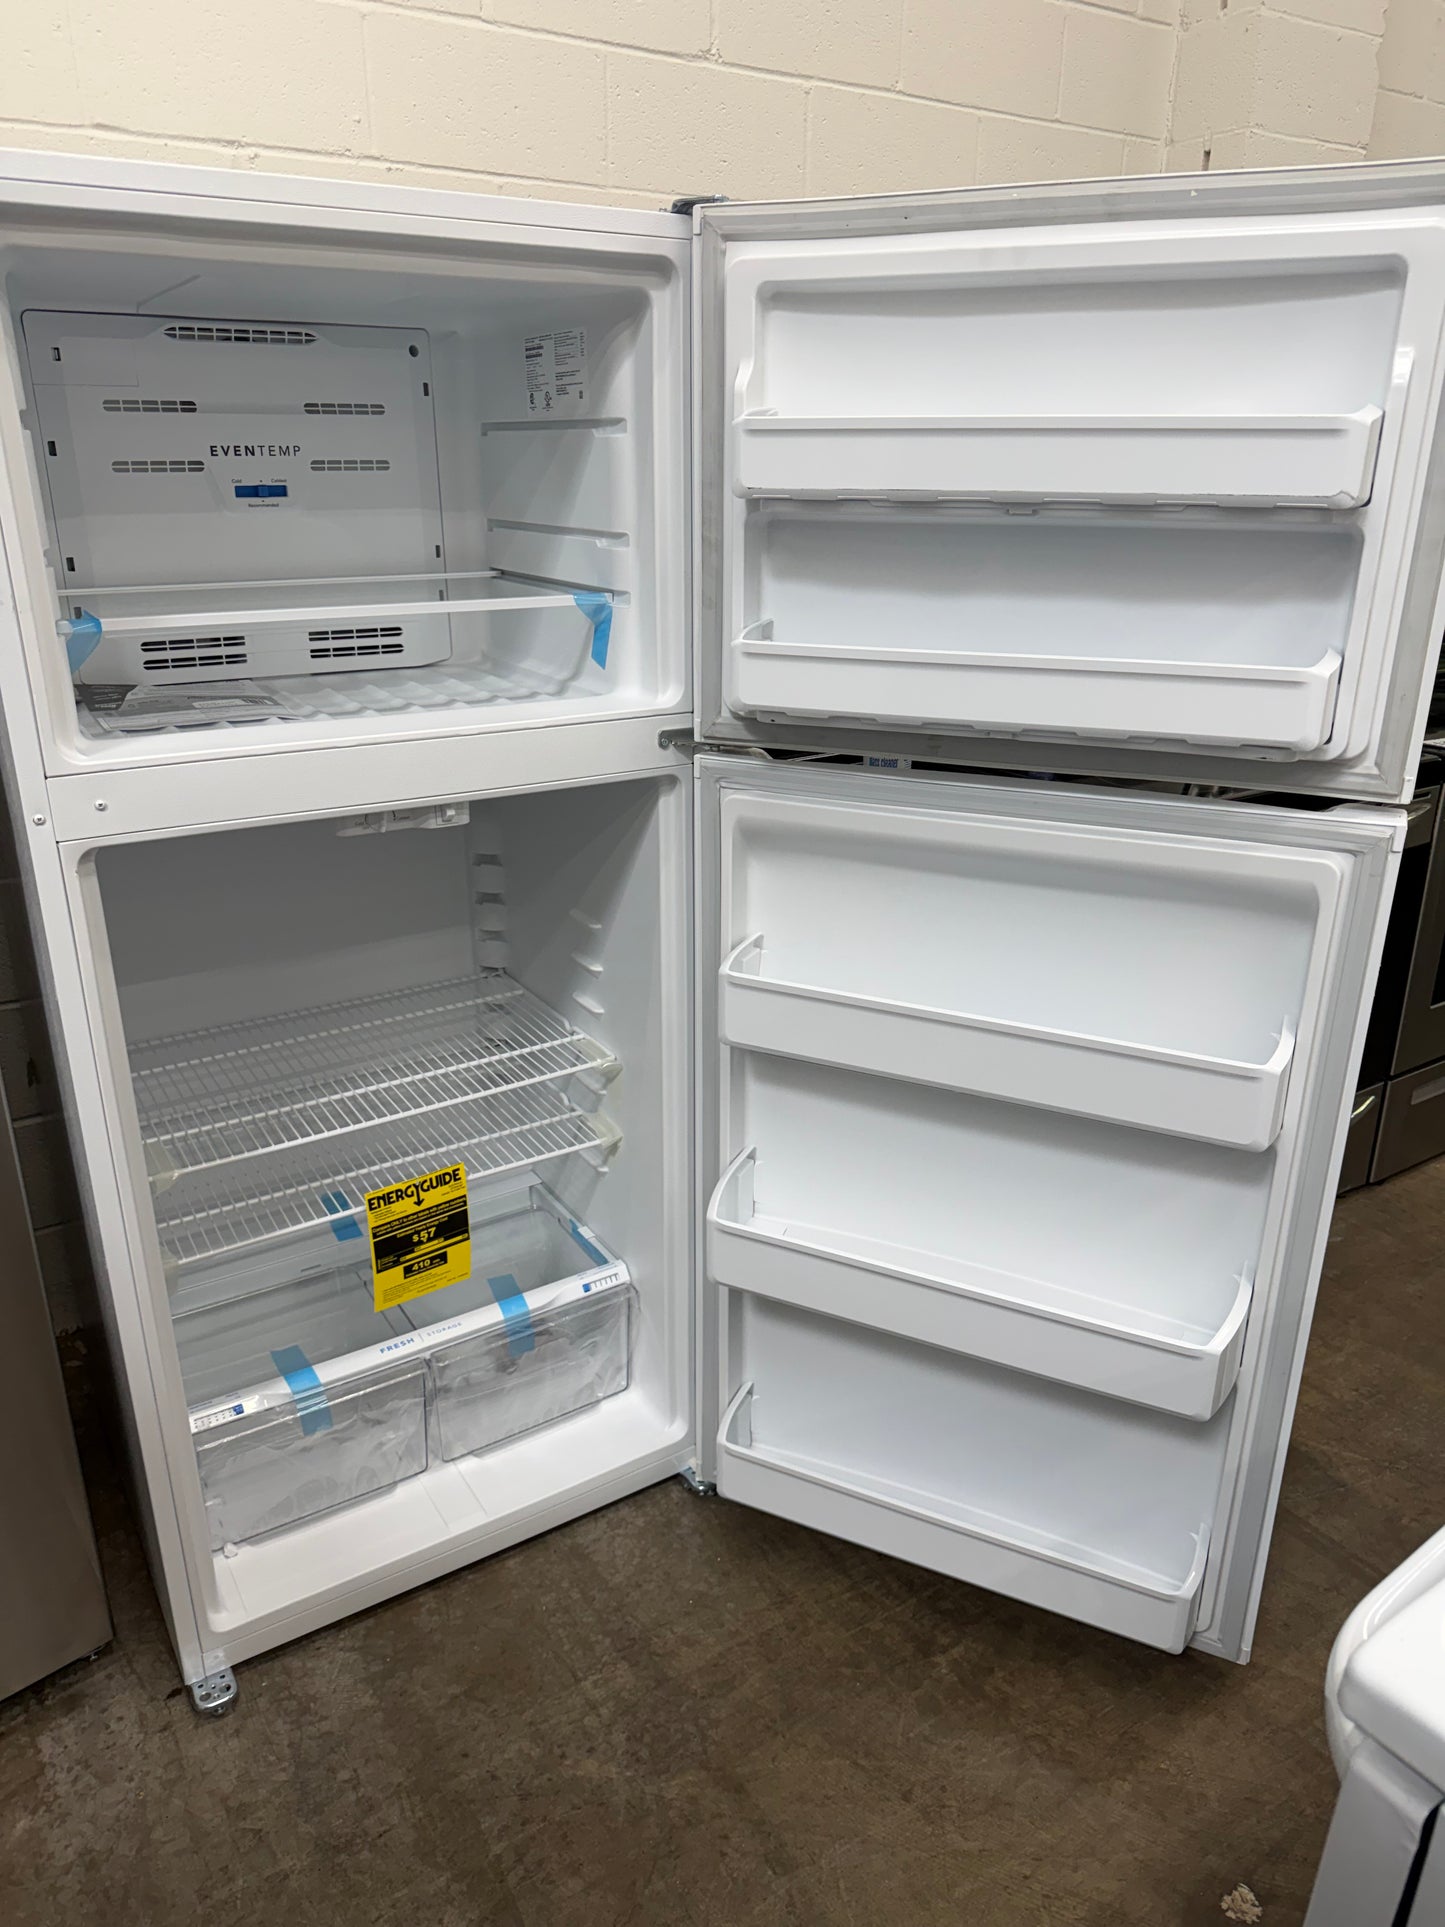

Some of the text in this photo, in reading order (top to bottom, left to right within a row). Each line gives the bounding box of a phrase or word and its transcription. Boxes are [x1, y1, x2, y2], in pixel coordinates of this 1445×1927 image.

[210, 445, 301, 457] EVENTEMP
[412, 1227, 436, 1242] $57
[412, 1259, 431, 1271] 410
[380, 1321, 463, 1354] FRESH STORAGE
